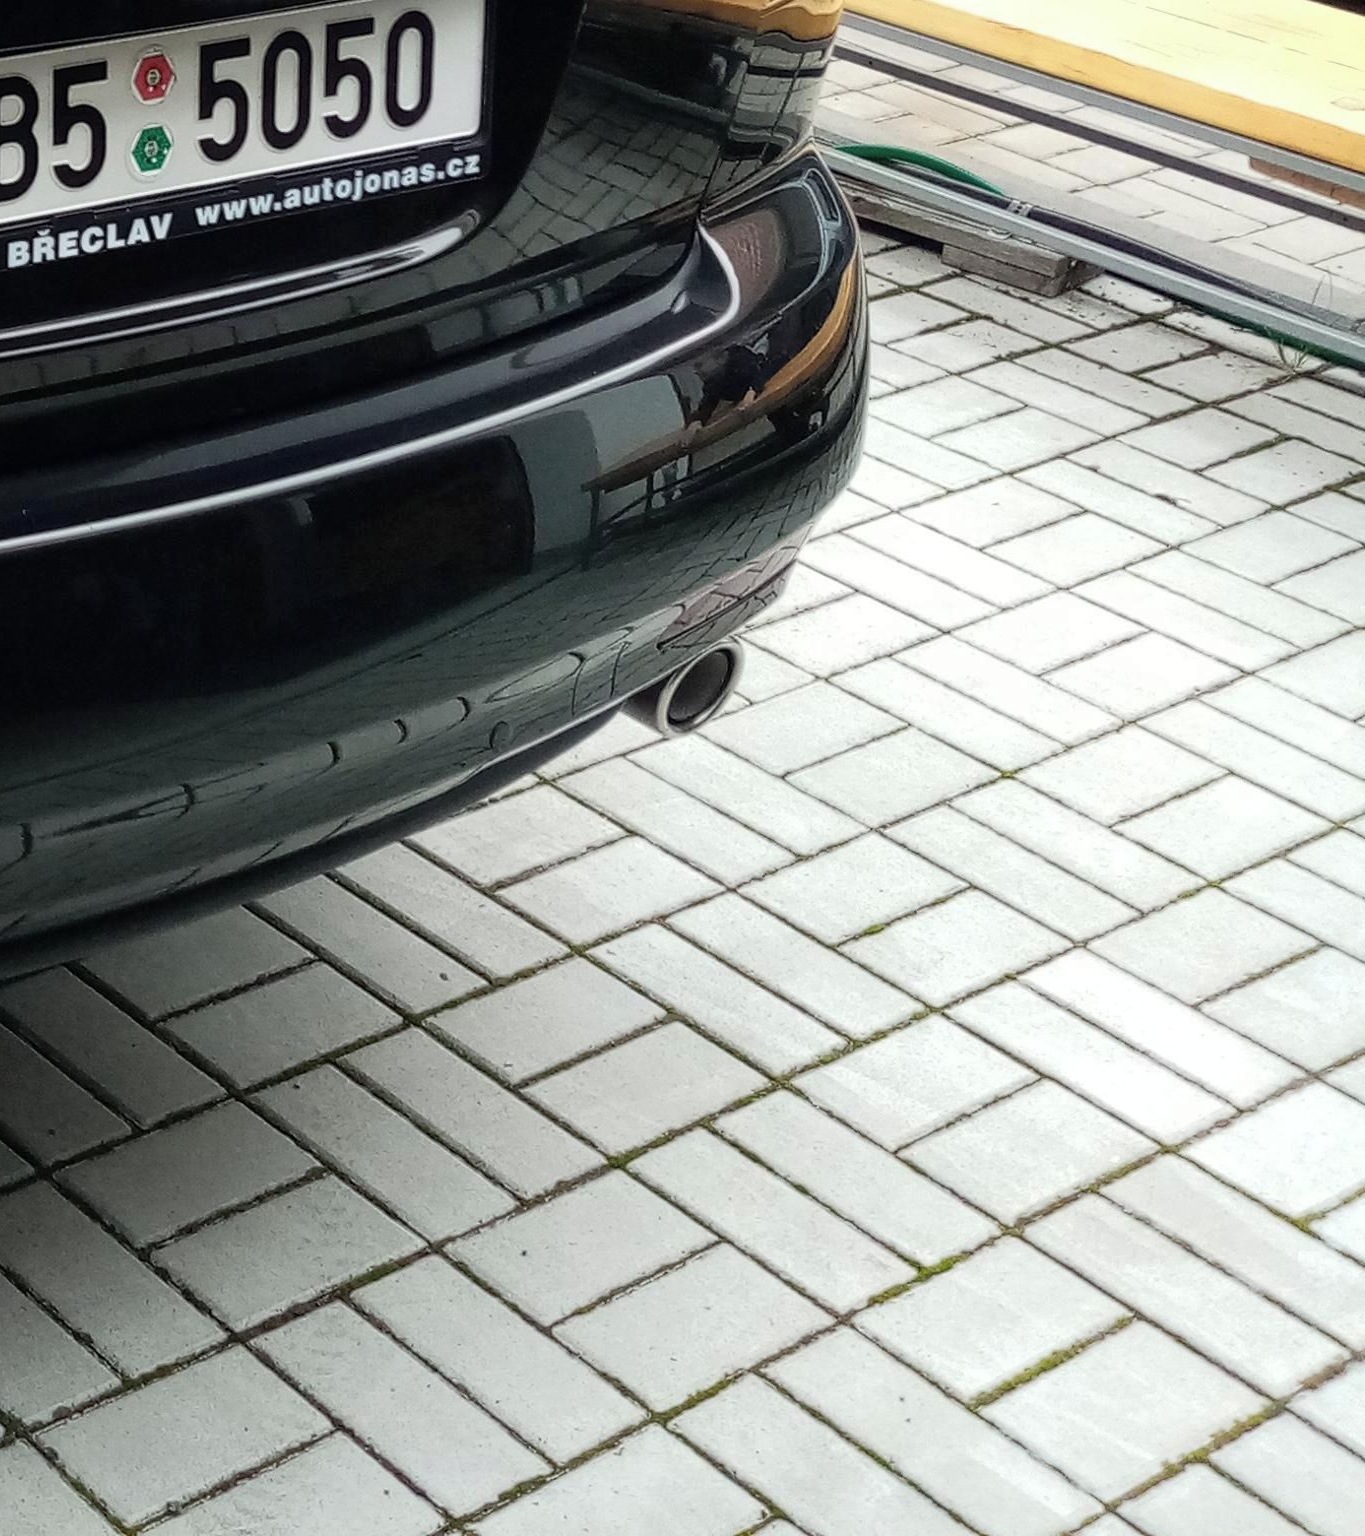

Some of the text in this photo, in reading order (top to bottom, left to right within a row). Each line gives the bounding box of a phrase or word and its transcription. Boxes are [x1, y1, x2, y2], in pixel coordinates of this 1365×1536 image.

[197, 10, 434, 162] 5050
[7, 212, 173, 268] BŘECLAV
[195, 154, 481, 226] www.autojonas.cz
